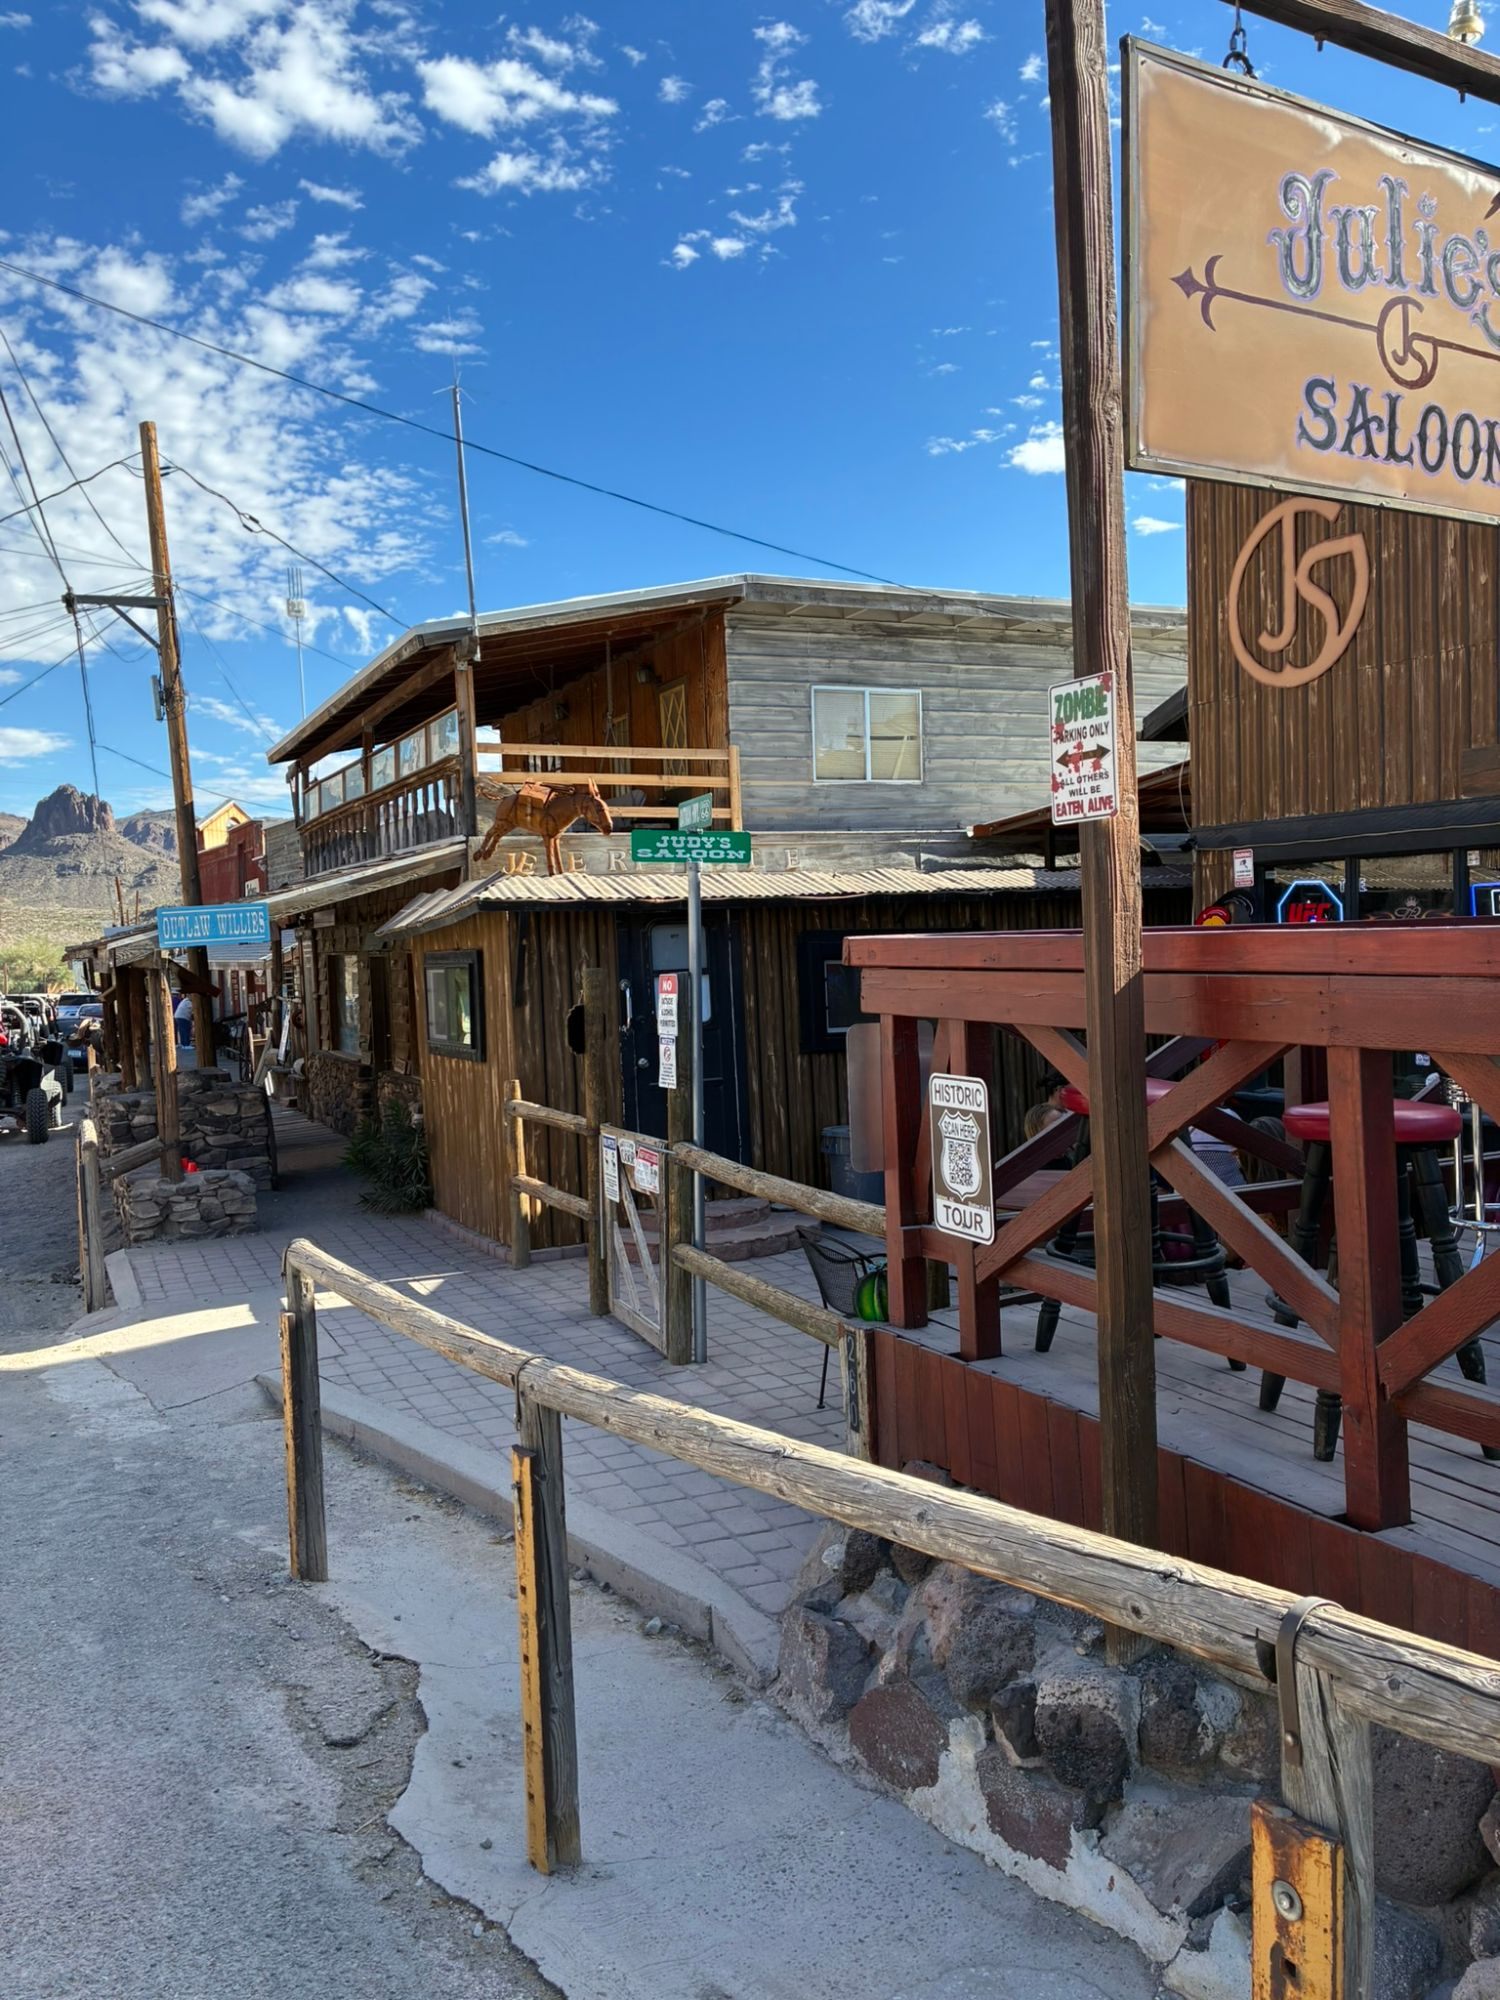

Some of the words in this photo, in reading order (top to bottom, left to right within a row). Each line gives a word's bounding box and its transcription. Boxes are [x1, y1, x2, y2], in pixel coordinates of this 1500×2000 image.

[1054, 684, 1108, 725] ZOMBIE
[1089, 720, 1110, 738] ONLY
[1076, 770, 1110, 784] OTHERS
[1069, 787, 1088, 797] WILL
[1090, 784, 1101, 794] BE
[1056, 800, 1084, 817] EATEN
[1087, 795, 1114, 813] ALIVE
[656, 835, 731, 849] JUDY'S
[636, 848, 746, 860] SALOON
[1288, 903, 1331, 922] UFC
[162, 914, 211, 939] OUTLAW
[662, 979, 673, 992] NO
[934, 1083, 983, 1107] HISTORIC
[943, 1120, 960, 1137] SCAN
[960, 1123, 976, 1140] HERE
[942, 1203, 984, 1234] TOUR
[847, 1335, 859, 1428] 260
